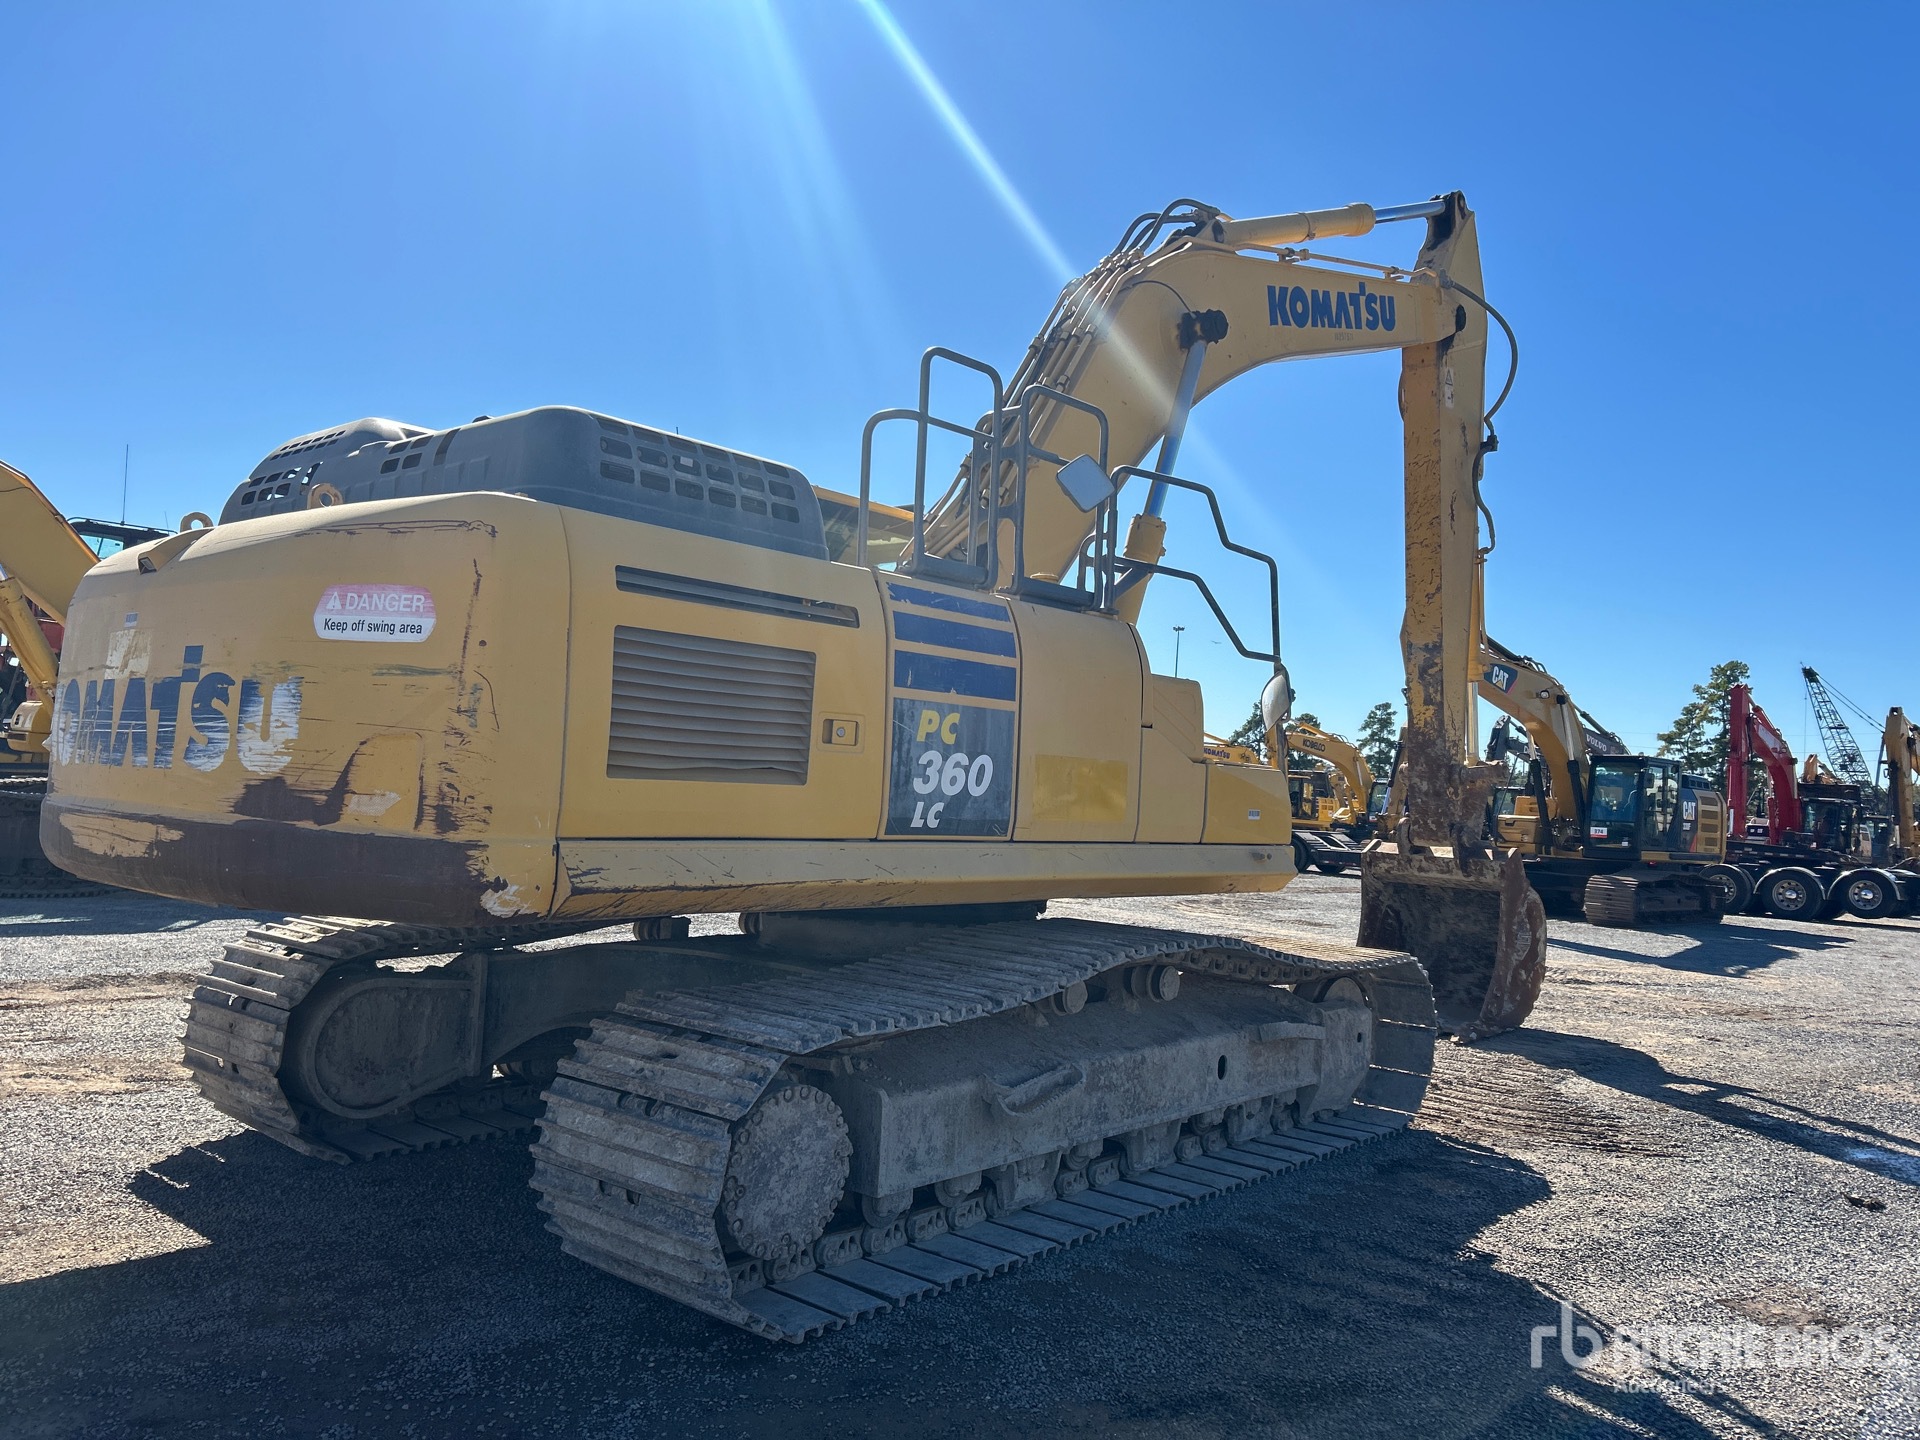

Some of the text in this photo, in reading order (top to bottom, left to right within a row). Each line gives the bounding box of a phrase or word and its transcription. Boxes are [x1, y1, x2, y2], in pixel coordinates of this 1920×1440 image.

[1266, 281, 1397, 332] KOMATSU
[345, 592, 425, 613] DANGER
[324, 618, 423, 635] Keep off swing area
[1492, 665, 1509, 691] CAT
[916, 709, 960, 745] PC
[1303, 738, 1326, 752] KOBELCO
[1586, 733, 1607, 752] VOLVO
[913, 750, 994, 797] 360
[910, 801, 945, 828] LC
[1682, 801, 1696, 820] CAT
